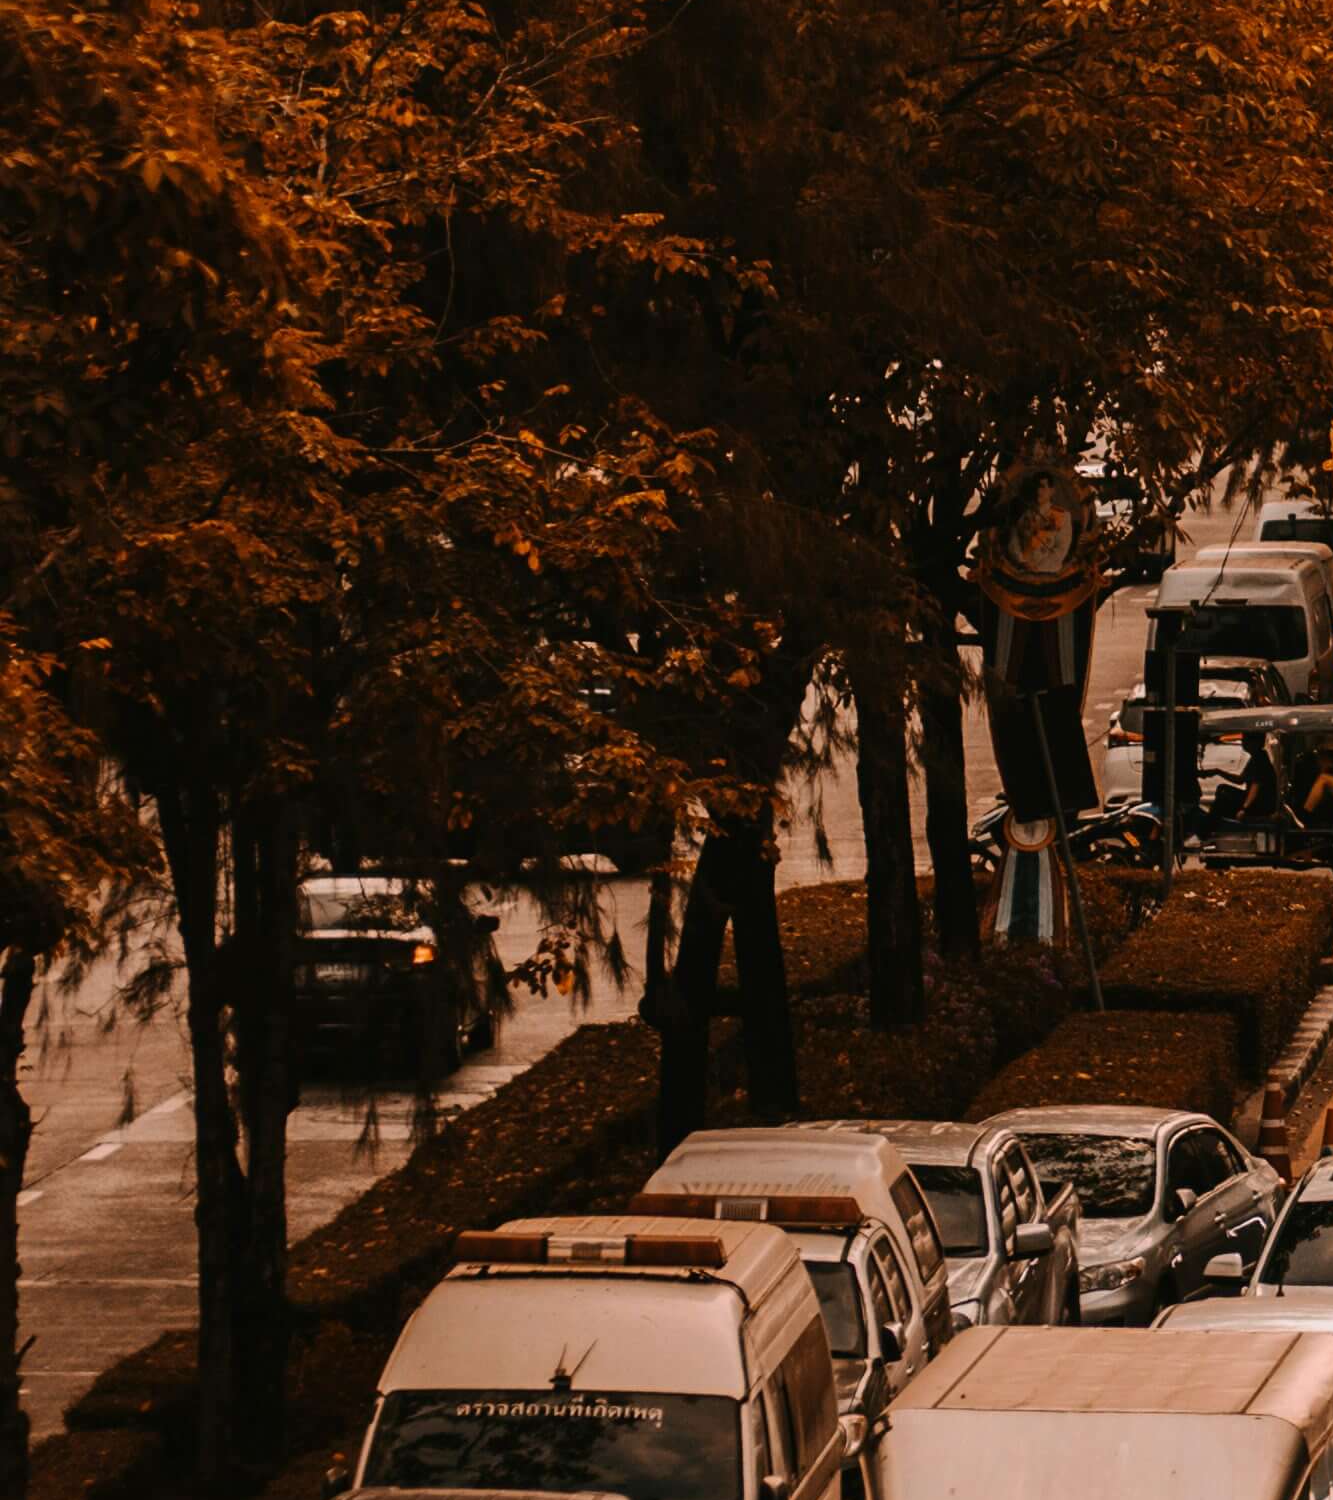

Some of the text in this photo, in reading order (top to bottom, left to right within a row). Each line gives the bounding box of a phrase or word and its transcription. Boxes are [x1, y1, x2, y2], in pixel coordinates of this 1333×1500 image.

[456, 1394, 664, 1428] ตรวจสถานที่เกิดเหตุ
